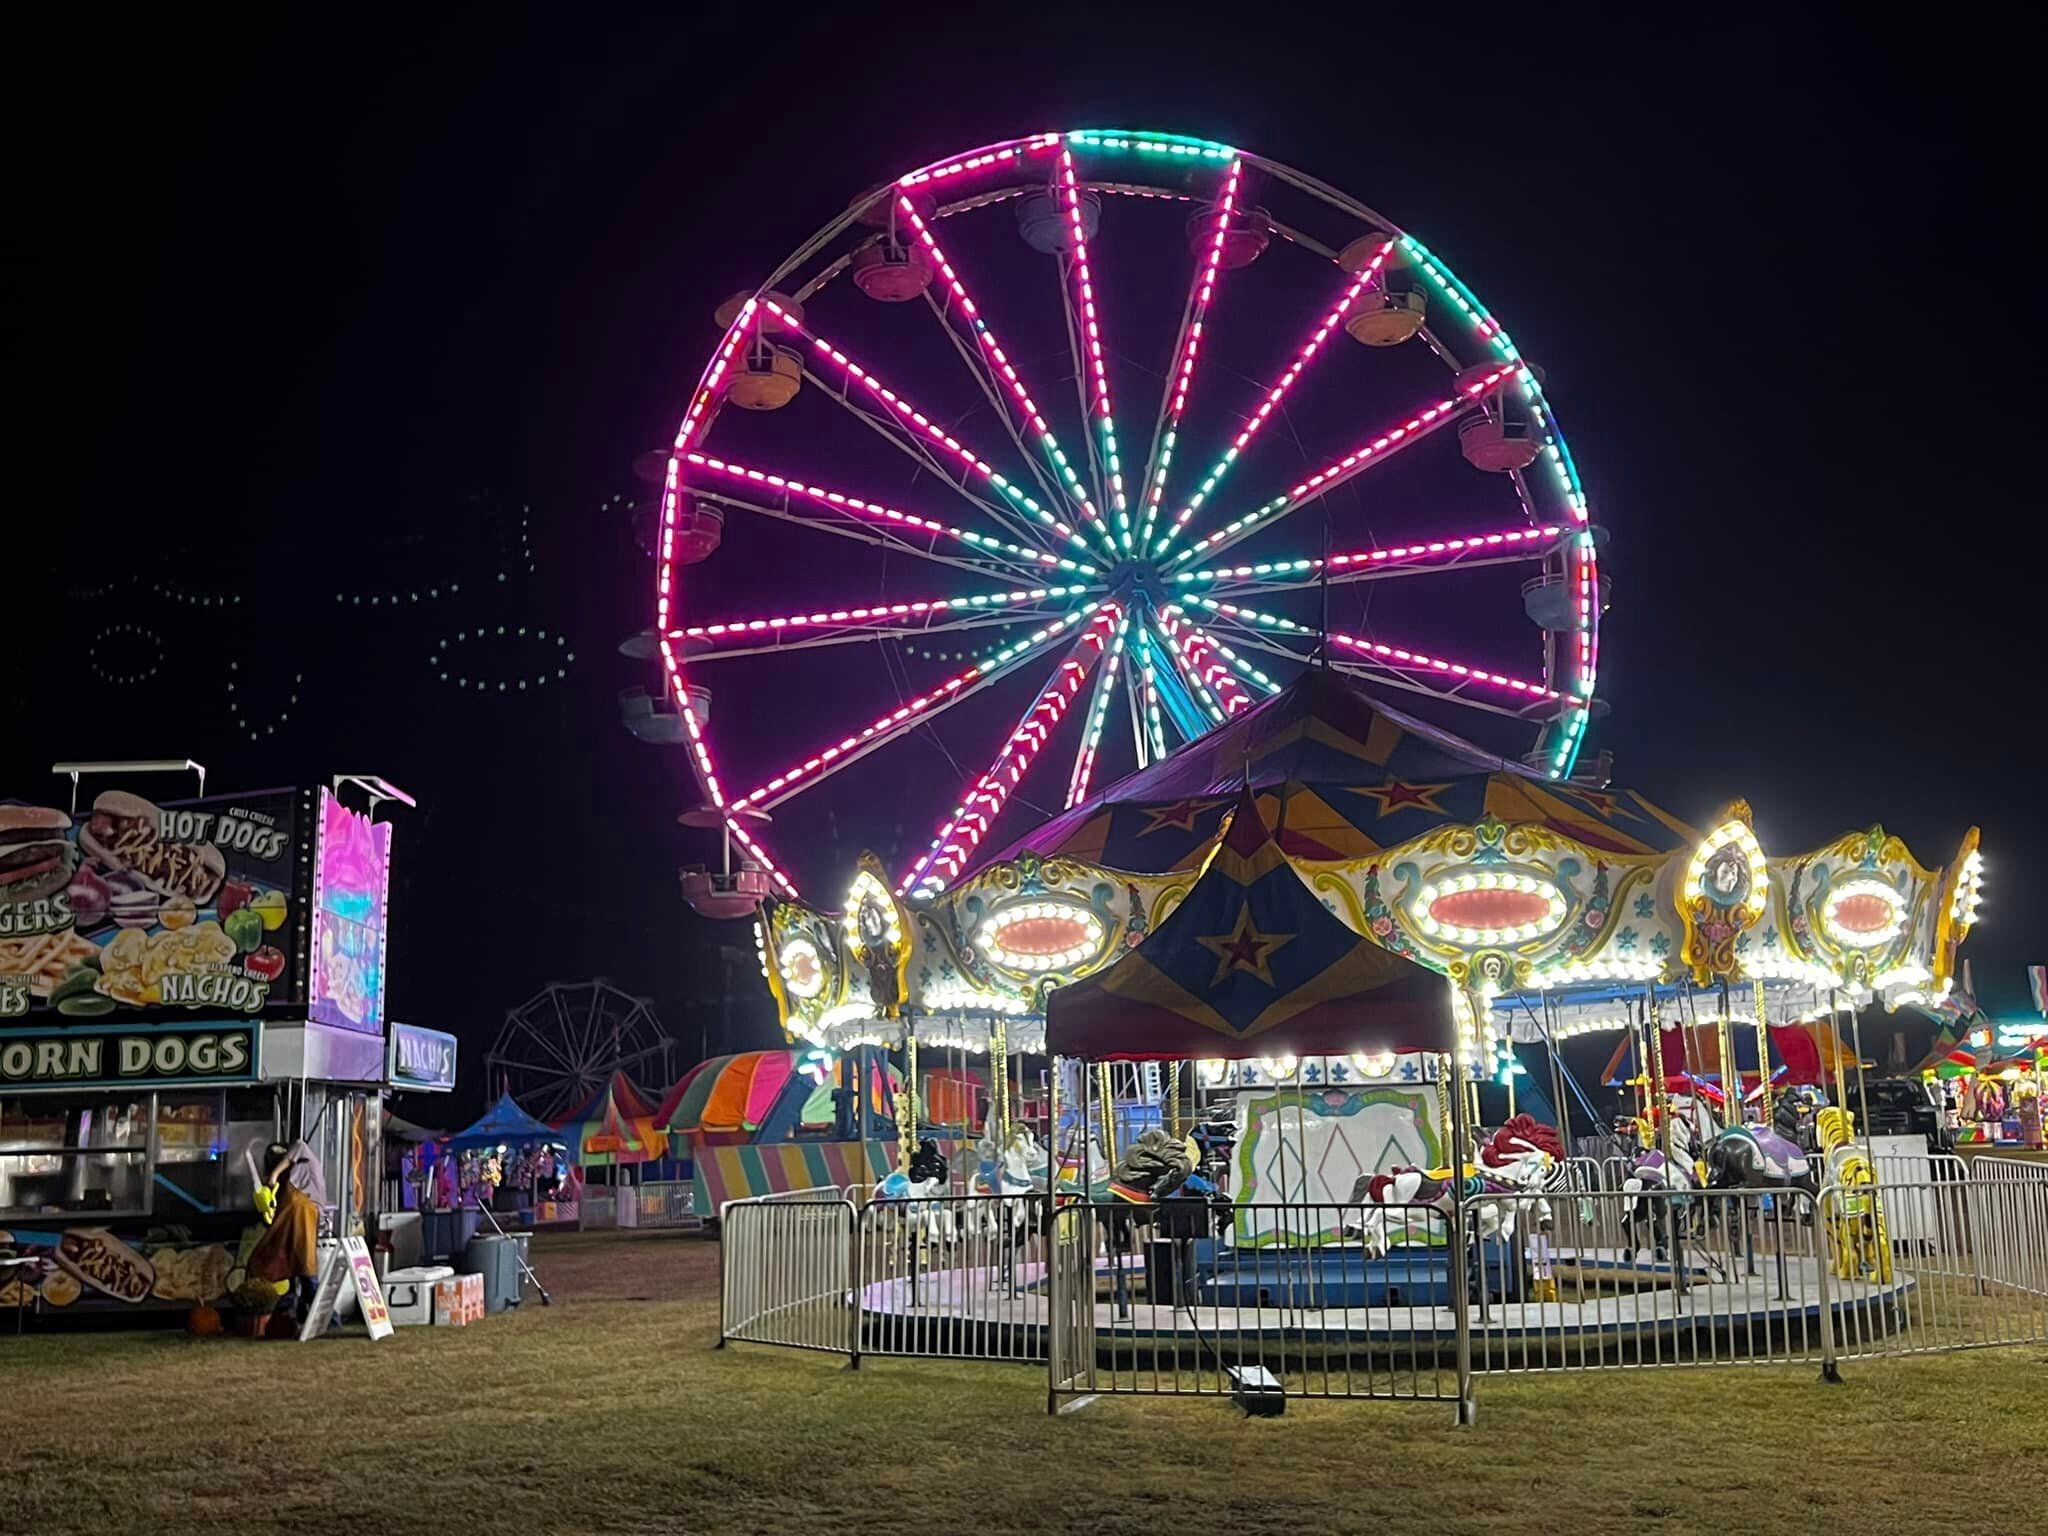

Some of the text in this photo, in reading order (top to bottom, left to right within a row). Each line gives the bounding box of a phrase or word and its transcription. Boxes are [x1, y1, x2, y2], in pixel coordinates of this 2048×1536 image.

[160, 811, 289, 859] HOT DOGS
[161, 974, 270, 1011] NACHOS
[119, 1034, 248, 1075] DOGS
[398, 1038, 450, 1074] NACHOS
